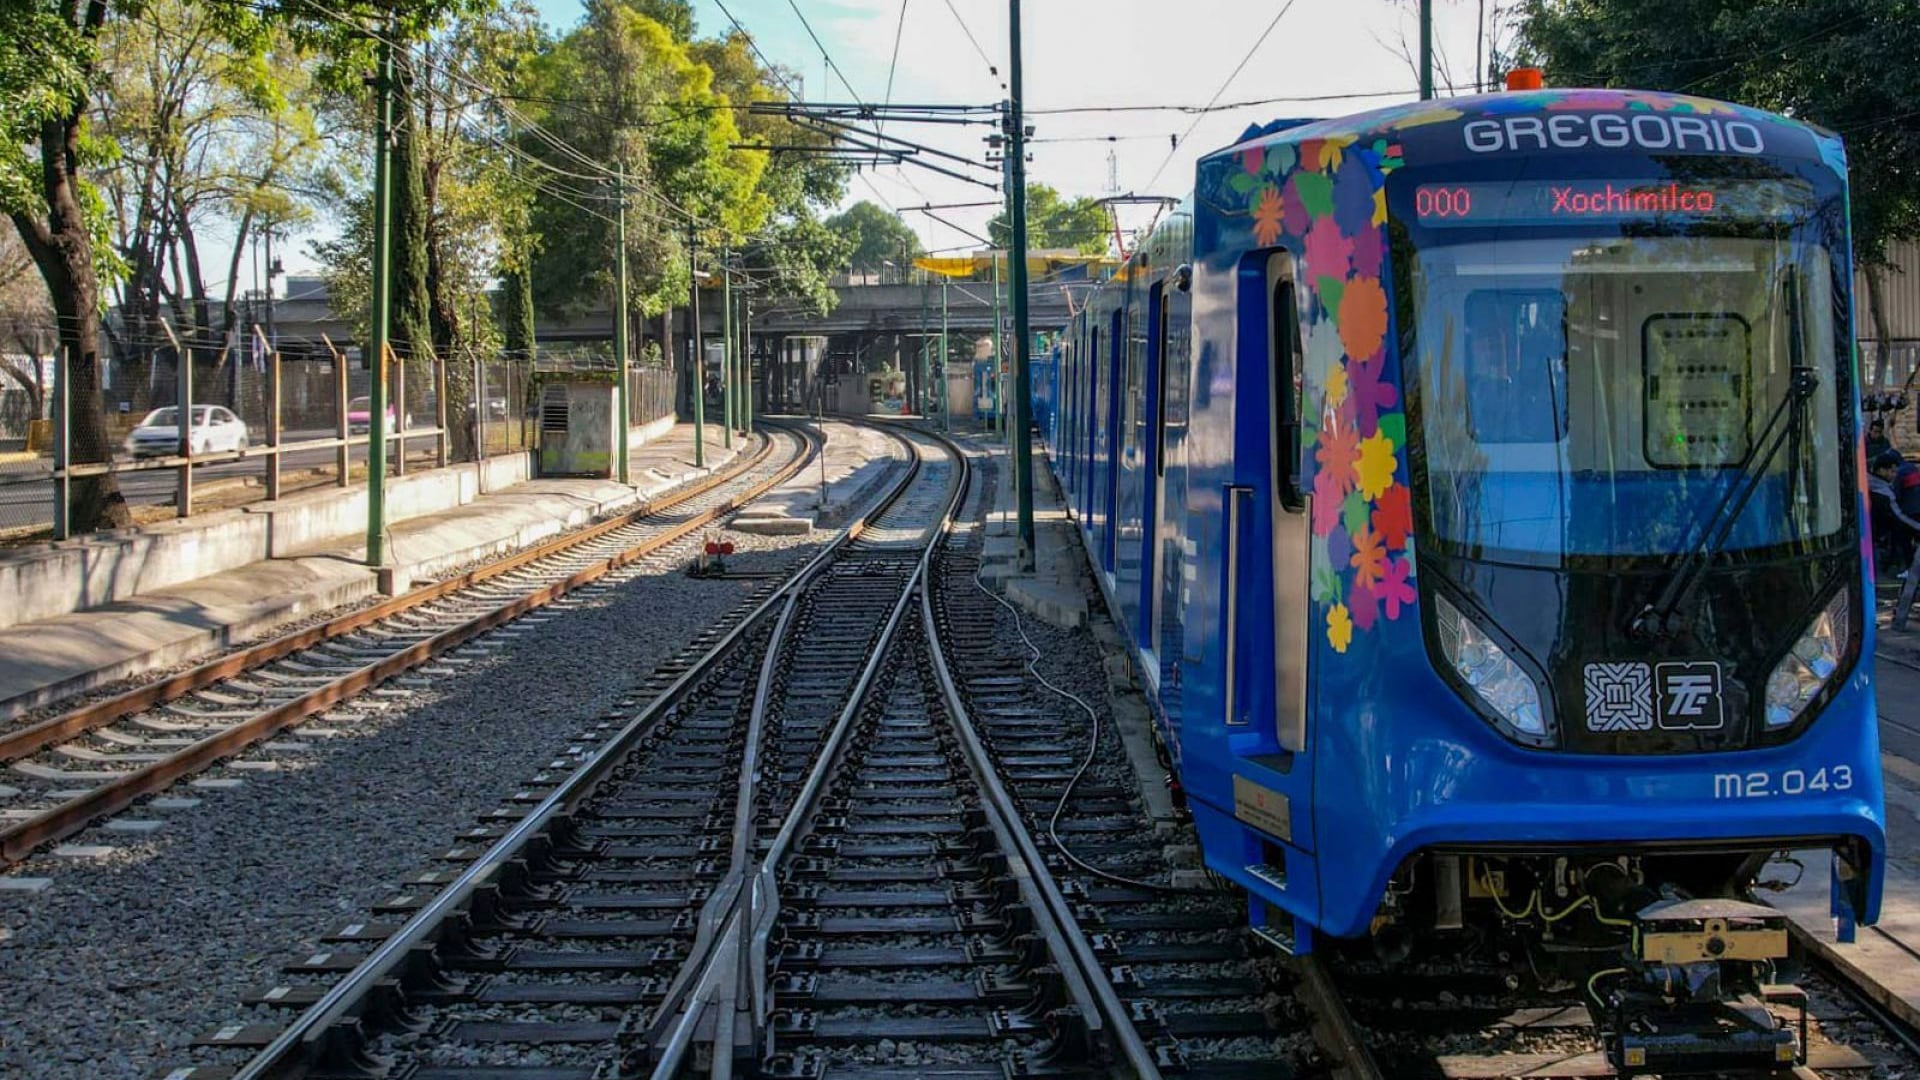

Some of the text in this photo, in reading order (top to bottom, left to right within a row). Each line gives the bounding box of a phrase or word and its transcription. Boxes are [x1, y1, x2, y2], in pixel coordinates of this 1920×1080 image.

[1463, 114, 1765, 154] GREGORIO
[1416, 183, 1714, 217] 000 Xochimilco
